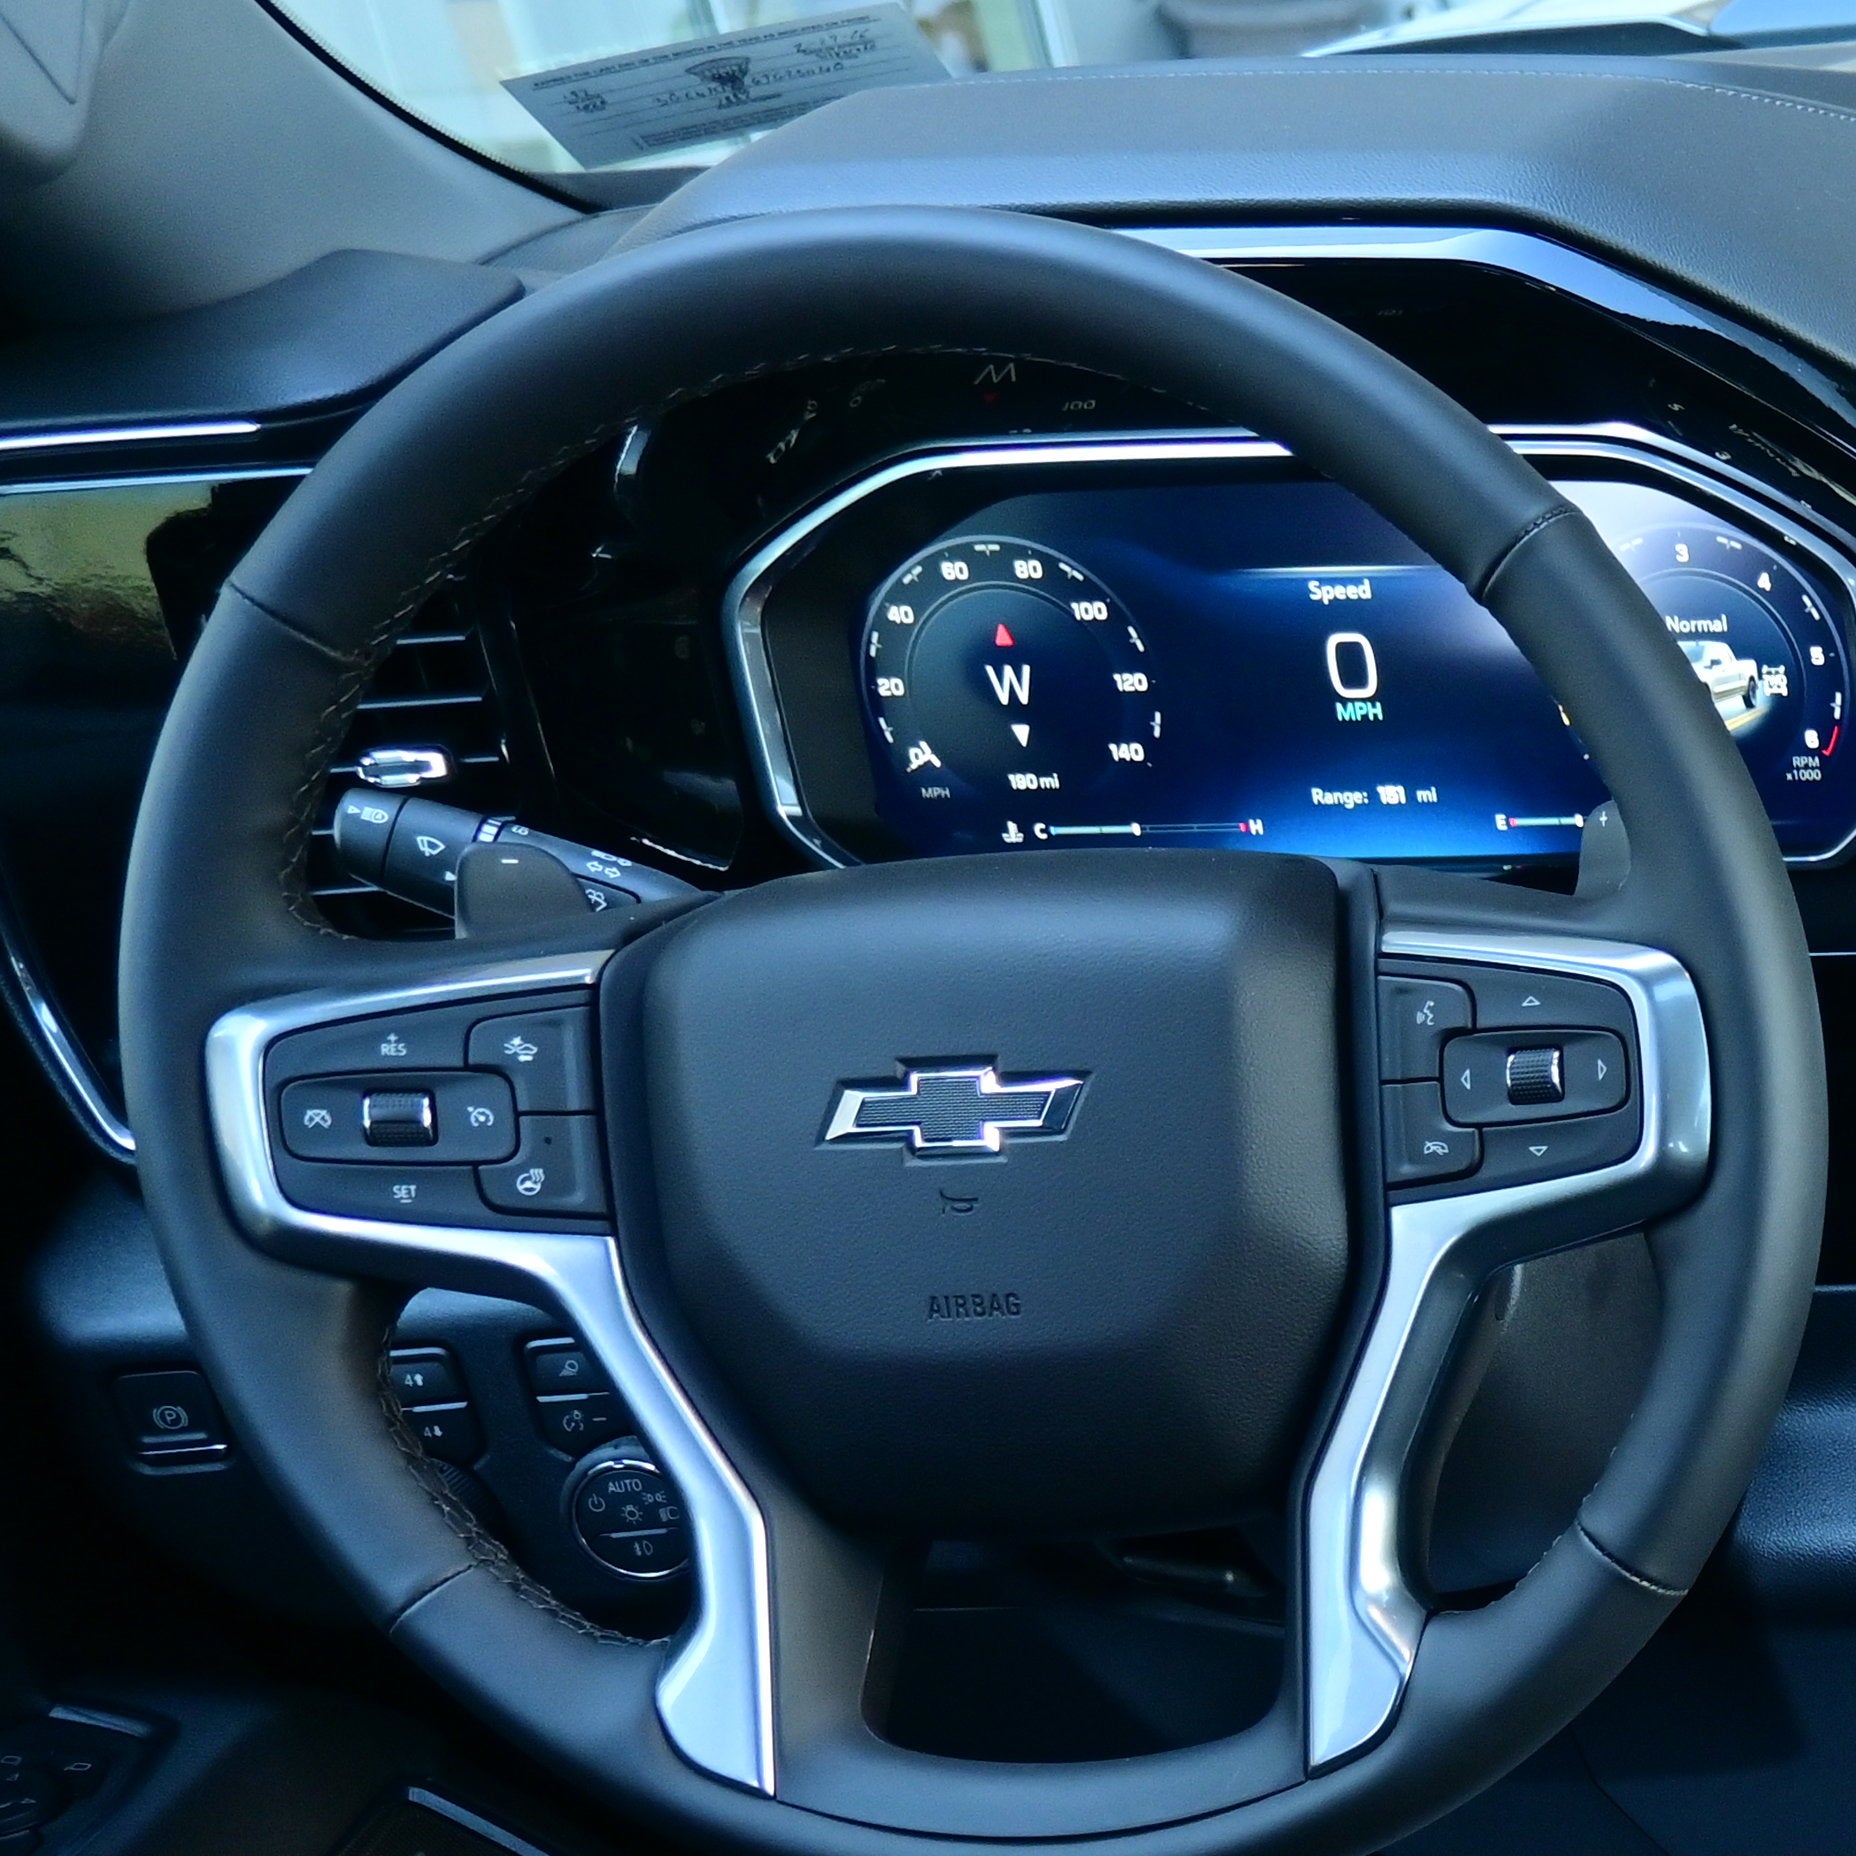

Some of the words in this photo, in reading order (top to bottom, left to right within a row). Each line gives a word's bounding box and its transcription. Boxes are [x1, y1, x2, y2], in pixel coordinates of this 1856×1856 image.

[1675, 544, 1689, 562] 3
[940, 561, 969, 581] 60
[1013, 559, 1043, 579] 80
[1757, 572, 1772, 591] 4
[1308, 579, 1372, 605] Speed
[887, 605, 914, 624] 40
[1070, 601, 1108, 621] 100
[1666, 614, 1728, 633] Normal
[1326, 632, 1378, 699] 0
[1809, 646, 1825, 666] 5
[876, 677, 905, 697] 20
[985, 664, 1030, 705] W
[1113, 673, 1149, 692] 120
[1336, 702, 1383, 721] MPH
[1109, 743, 1145, 762] 140
[1792, 756, 1820, 768] RPM
[1039, 773, 1060, 789] mi
[1786, 769, 1821, 781] x1000
[921, 786, 951, 800] MPH
[1311, 788, 1369, 809] Range:
[1416, 786, 1438, 803] mi
[1033, 822, 1048, 840] C
[1249, 819, 1264, 835] H
[1495, 814, 1508, 830] E
[381, 1043, 407, 1056] RES
[393, 1185, 416, 1198] SET
[927, 1293, 1021, 1320] AIRBAG
[607, 1479, 642, 1494] AUTO
